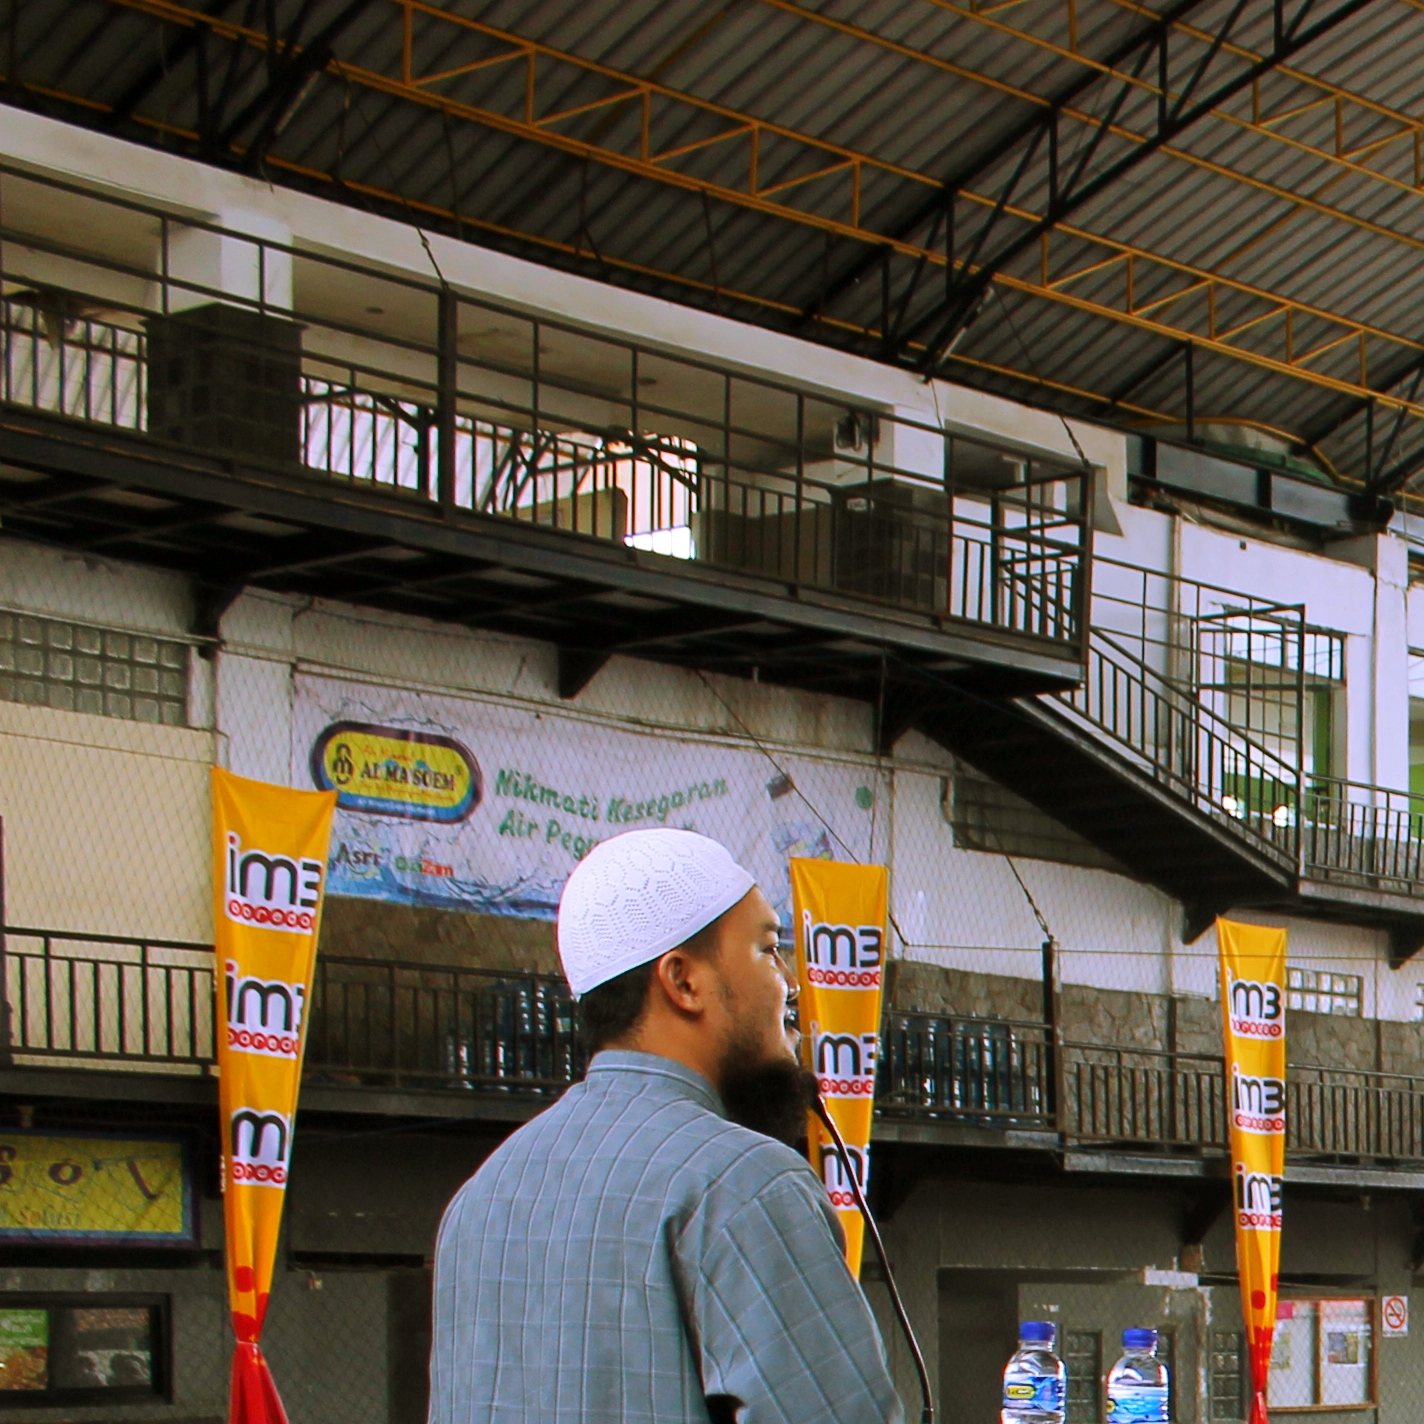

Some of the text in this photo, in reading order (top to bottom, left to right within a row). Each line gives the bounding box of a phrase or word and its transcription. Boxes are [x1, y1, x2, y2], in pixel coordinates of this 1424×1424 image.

[494, 768, 599, 820] Nikmati
[606, 777, 728, 823] Kesegaran
[498, 809, 538, 838] Air
[229, 835, 321, 908] im3
[228, 898, 315, 930] ooredo
[804, 912, 882, 967] im3
[1233, 1065, 1284, 1114] im3
